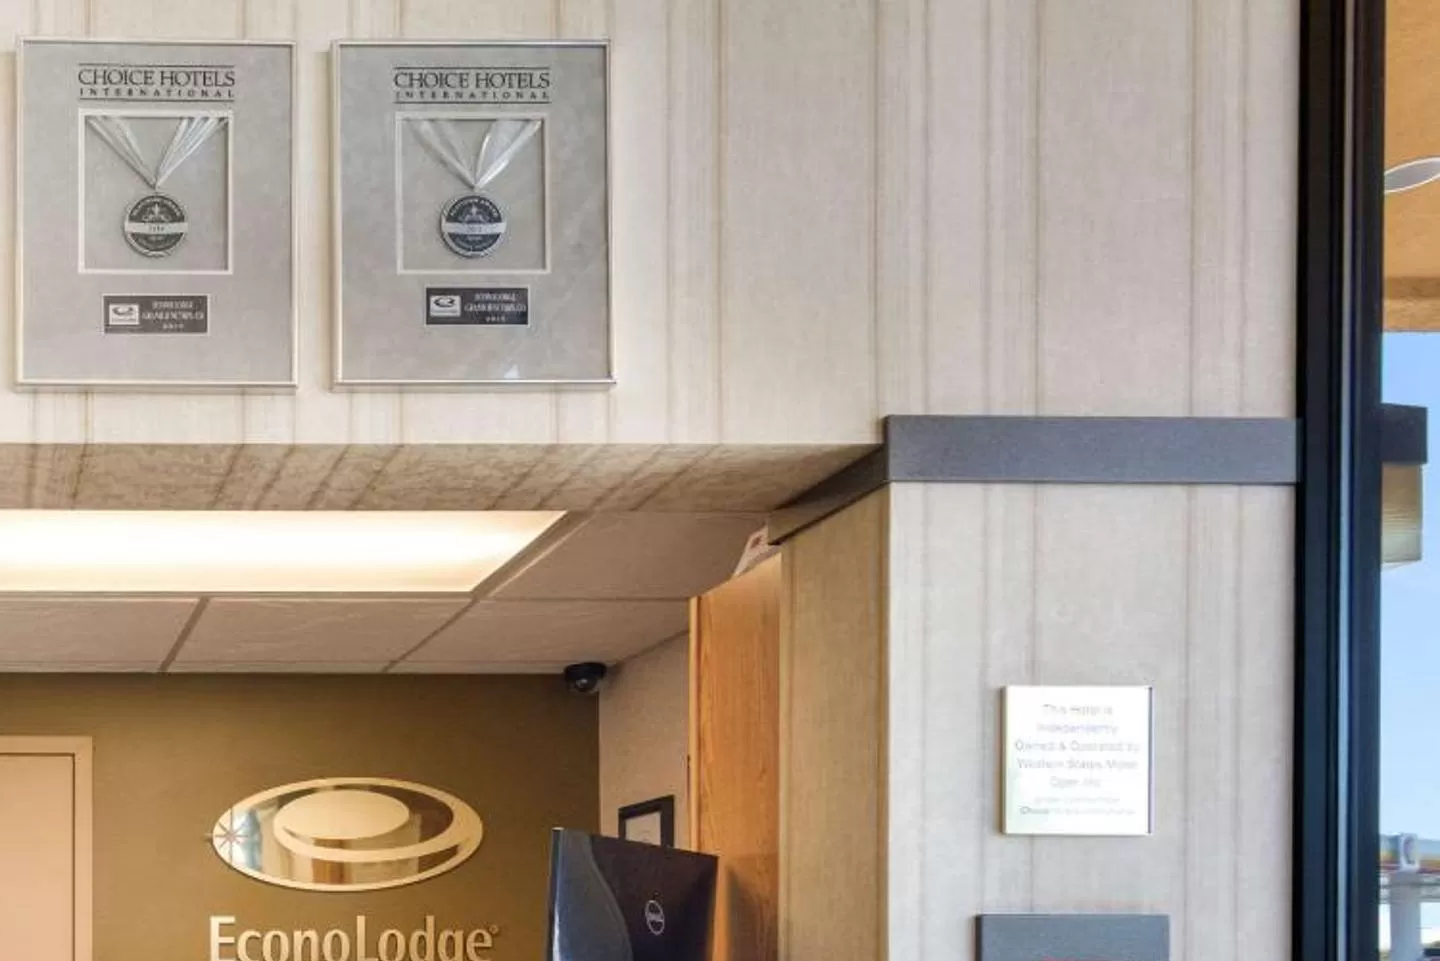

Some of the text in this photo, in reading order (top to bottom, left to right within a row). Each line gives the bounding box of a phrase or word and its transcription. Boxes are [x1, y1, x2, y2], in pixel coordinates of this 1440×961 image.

[78, 69, 235, 87] CHOICE HOTELS
[393, 72, 550, 88] CHOICE HOTELS
[80, 88, 234, 98] INTERNATIONAL
[396, 91, 550, 100] INTERNATIONAL
